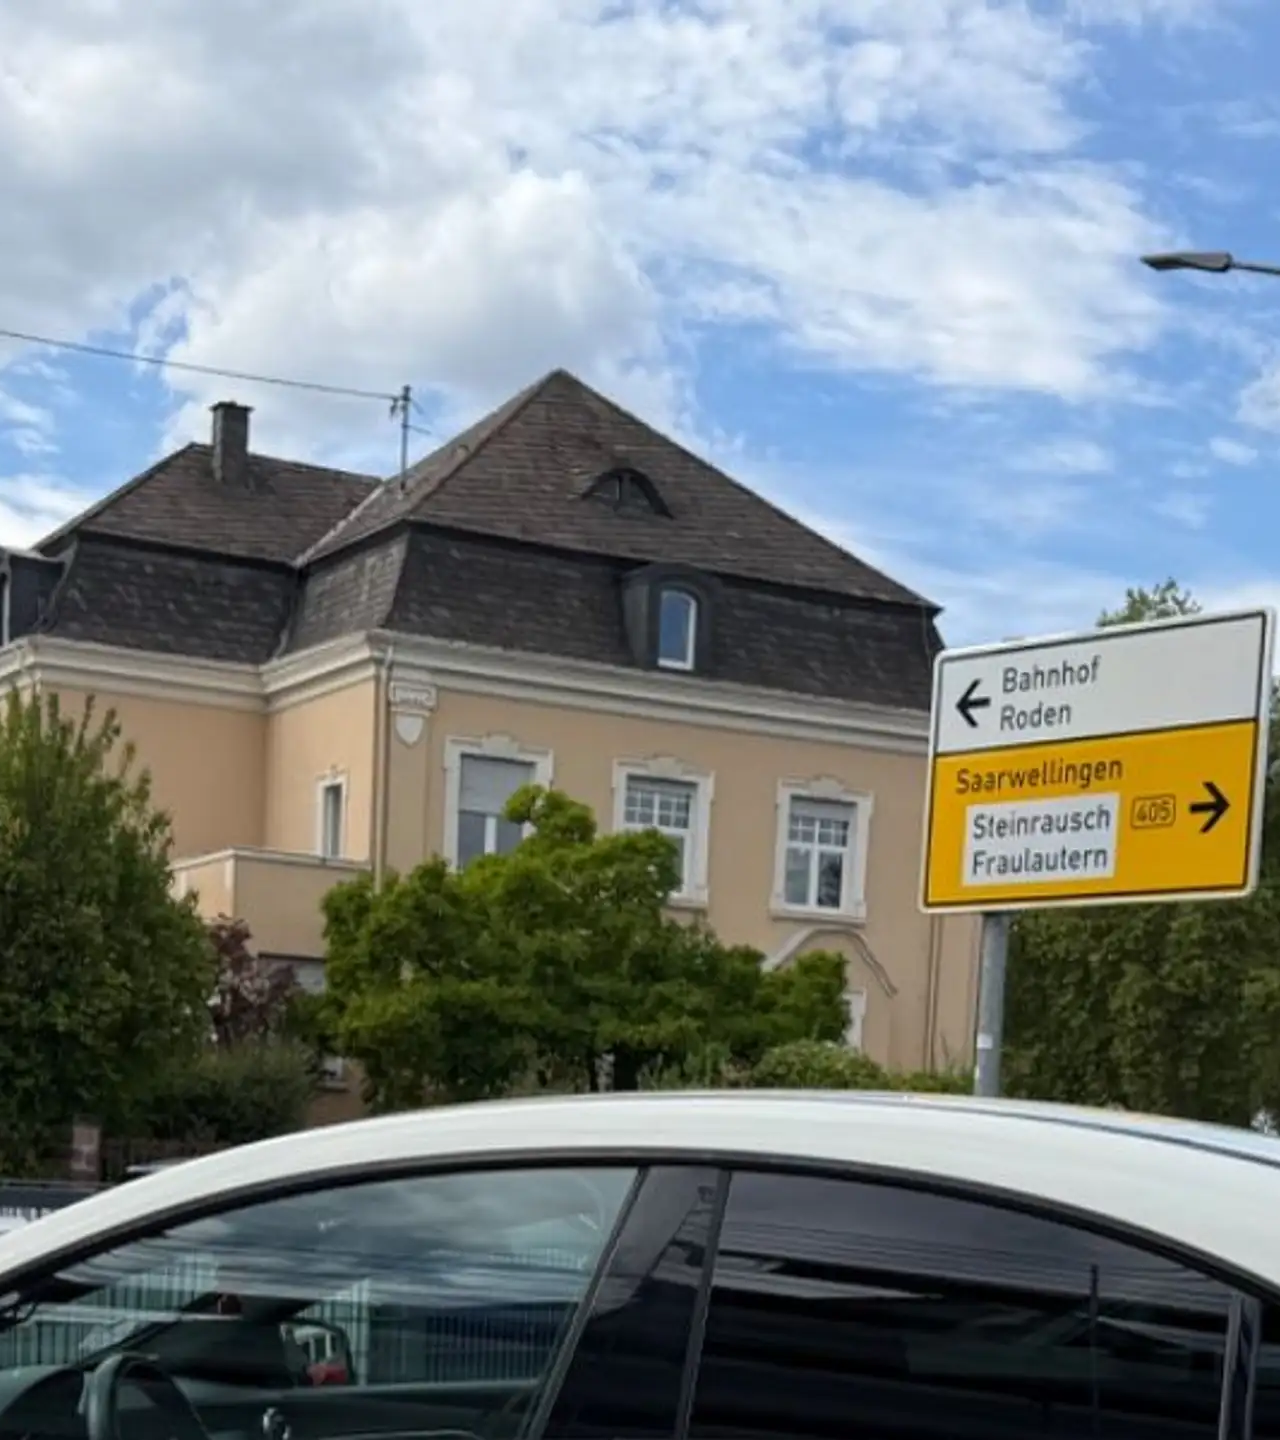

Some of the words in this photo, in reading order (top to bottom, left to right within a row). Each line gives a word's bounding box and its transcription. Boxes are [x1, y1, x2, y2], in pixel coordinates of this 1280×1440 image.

[1002, 654, 1102, 694] Bahnhof
[999, 700, 1072, 731] Roden
[955, 758, 1124, 795] Saarwellingen
[972, 804, 1112, 840] Steinrausch
[1135, 800, 1171, 823] 405
[971, 846, 1108, 877] Fraulautern
